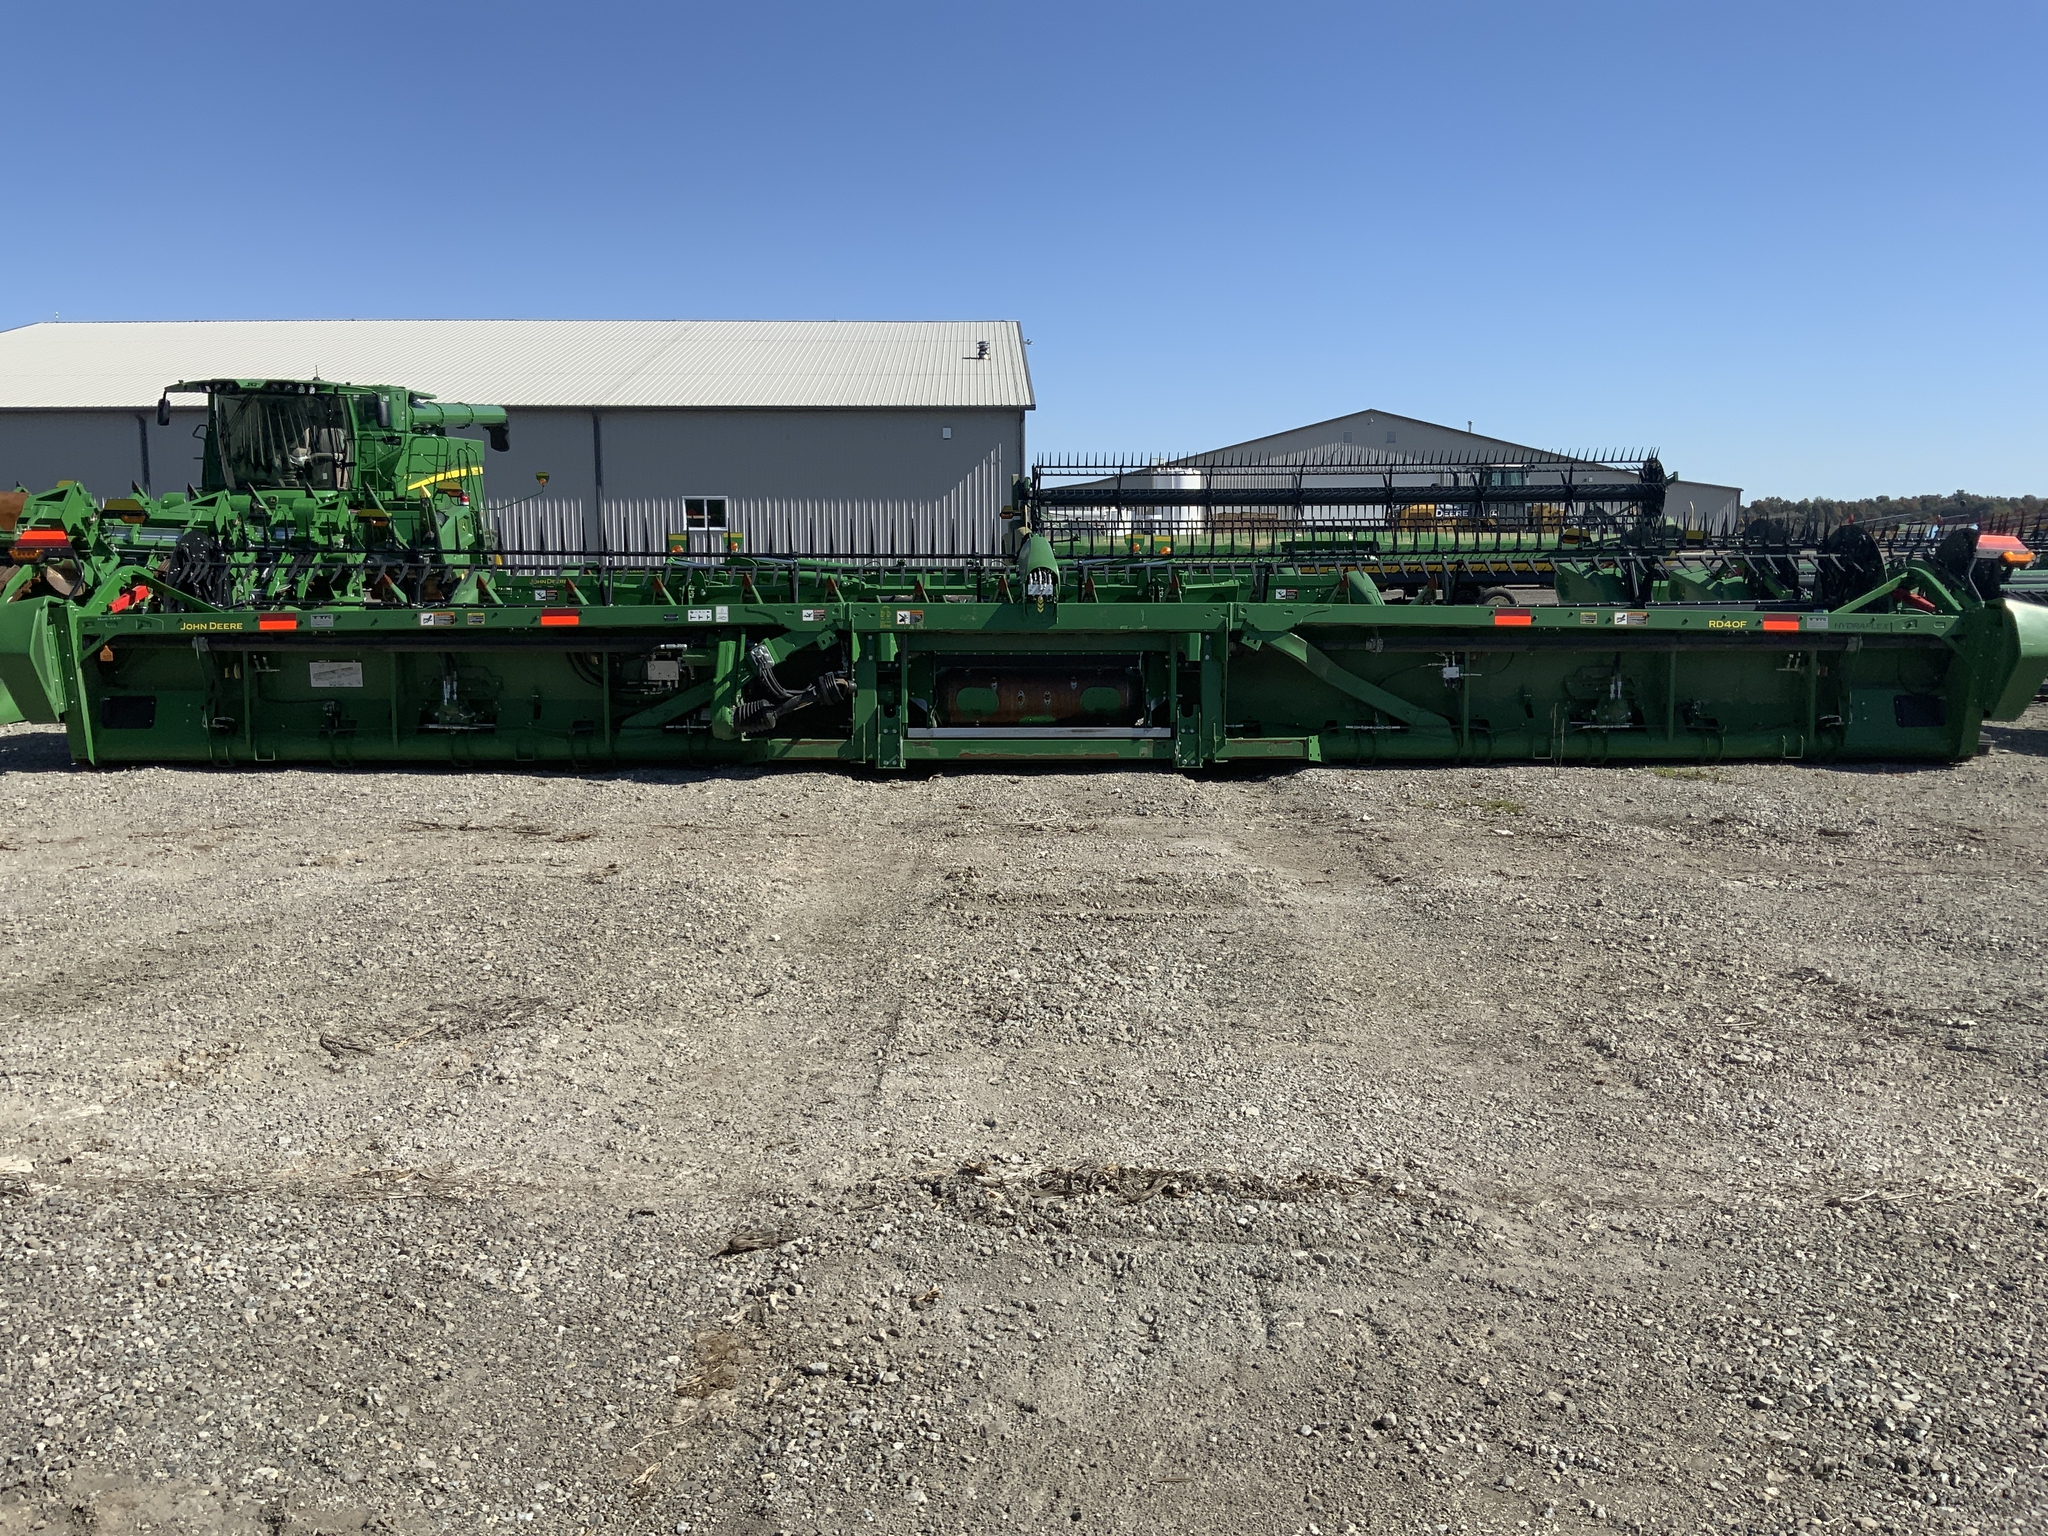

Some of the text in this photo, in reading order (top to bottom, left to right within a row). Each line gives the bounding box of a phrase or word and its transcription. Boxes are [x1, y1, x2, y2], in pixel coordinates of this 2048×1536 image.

[1435, 509, 1469, 518] DEERE
[180, 621, 243, 631] JOHN DEERE
[1708, 620, 1748, 629] RD40F
[1834, 622, 1890, 630] HYDRAFLEX
